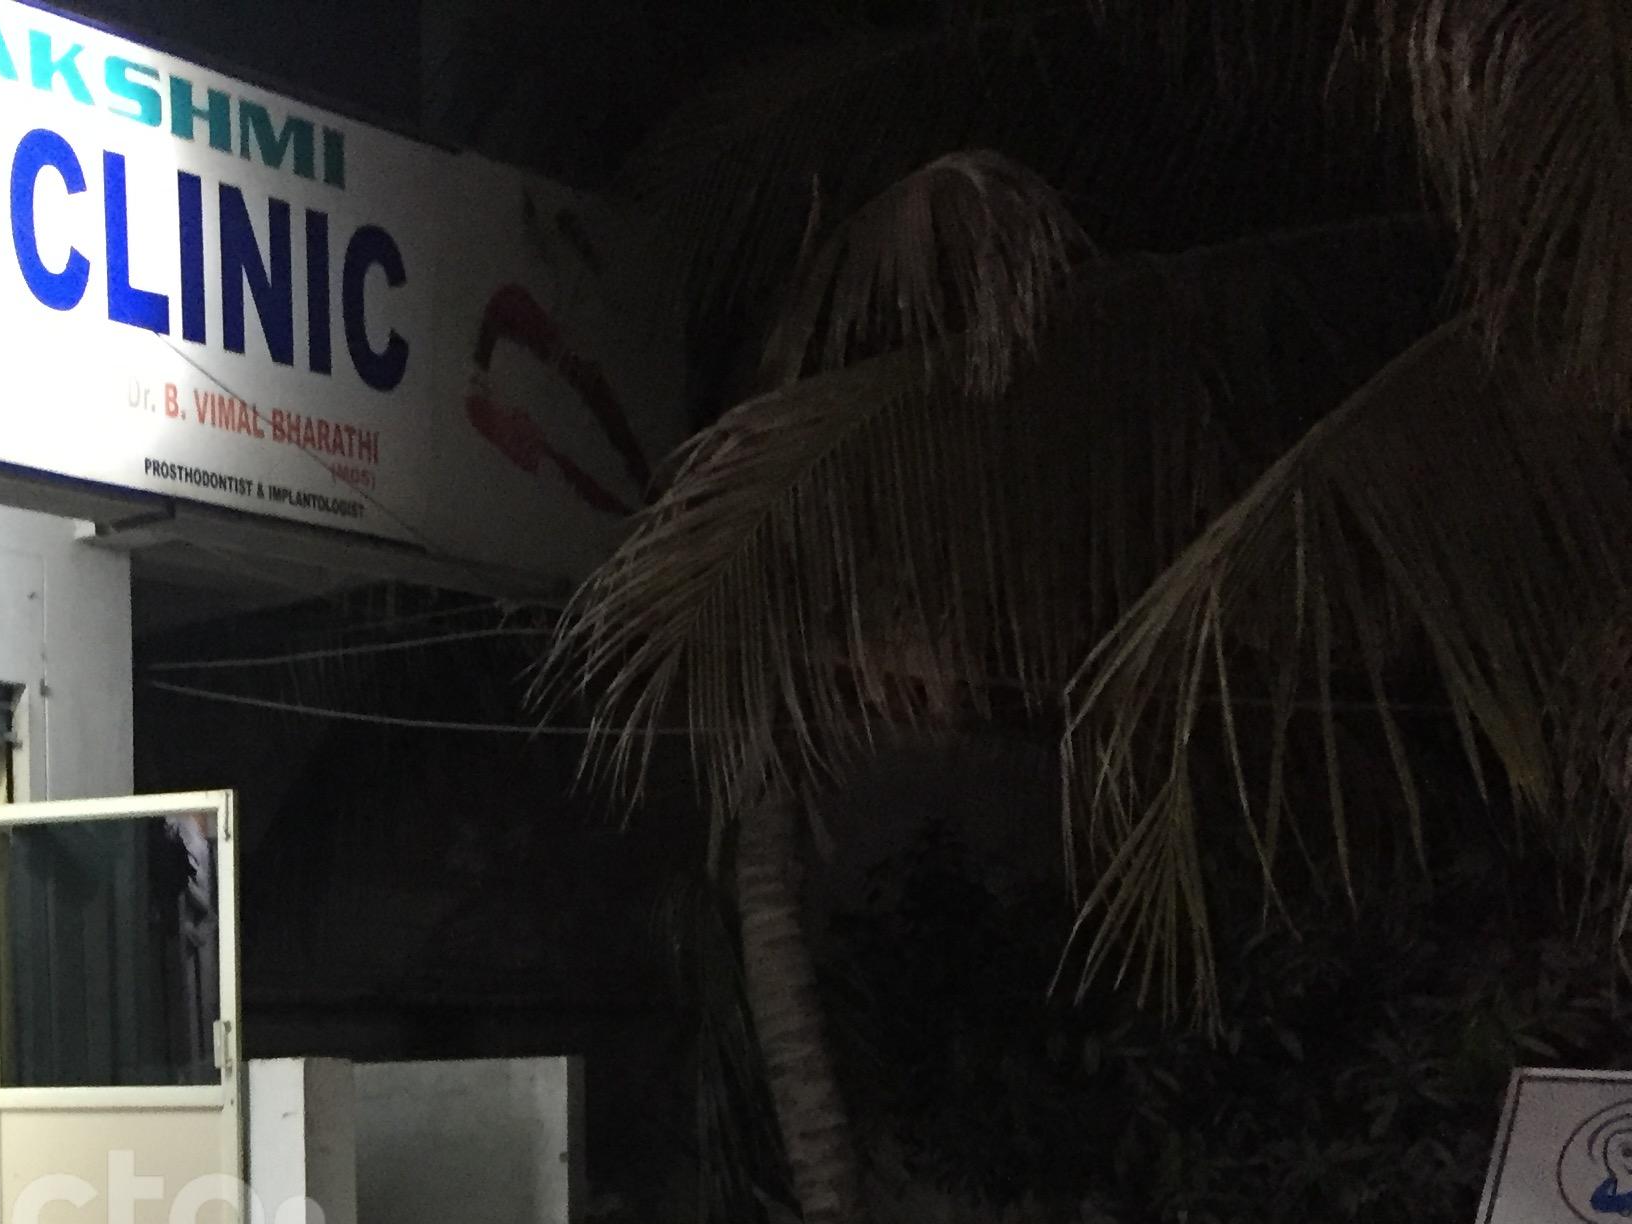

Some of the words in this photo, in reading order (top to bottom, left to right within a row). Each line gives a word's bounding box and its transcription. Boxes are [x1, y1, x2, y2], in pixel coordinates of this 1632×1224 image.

[10, 128, 410, 393] CLINIC
[127, 376, 156, 412] Dr.
[164, 383, 186, 420] B.
[193, 388, 265, 439] VIMAL
[272, 408, 380, 464] BHARATHI
[144, 457, 253, 497] PROSTHODONTIST
[257, 482, 265, 498] &
[269, 485, 365, 518] IMPLANTOLOGIST
